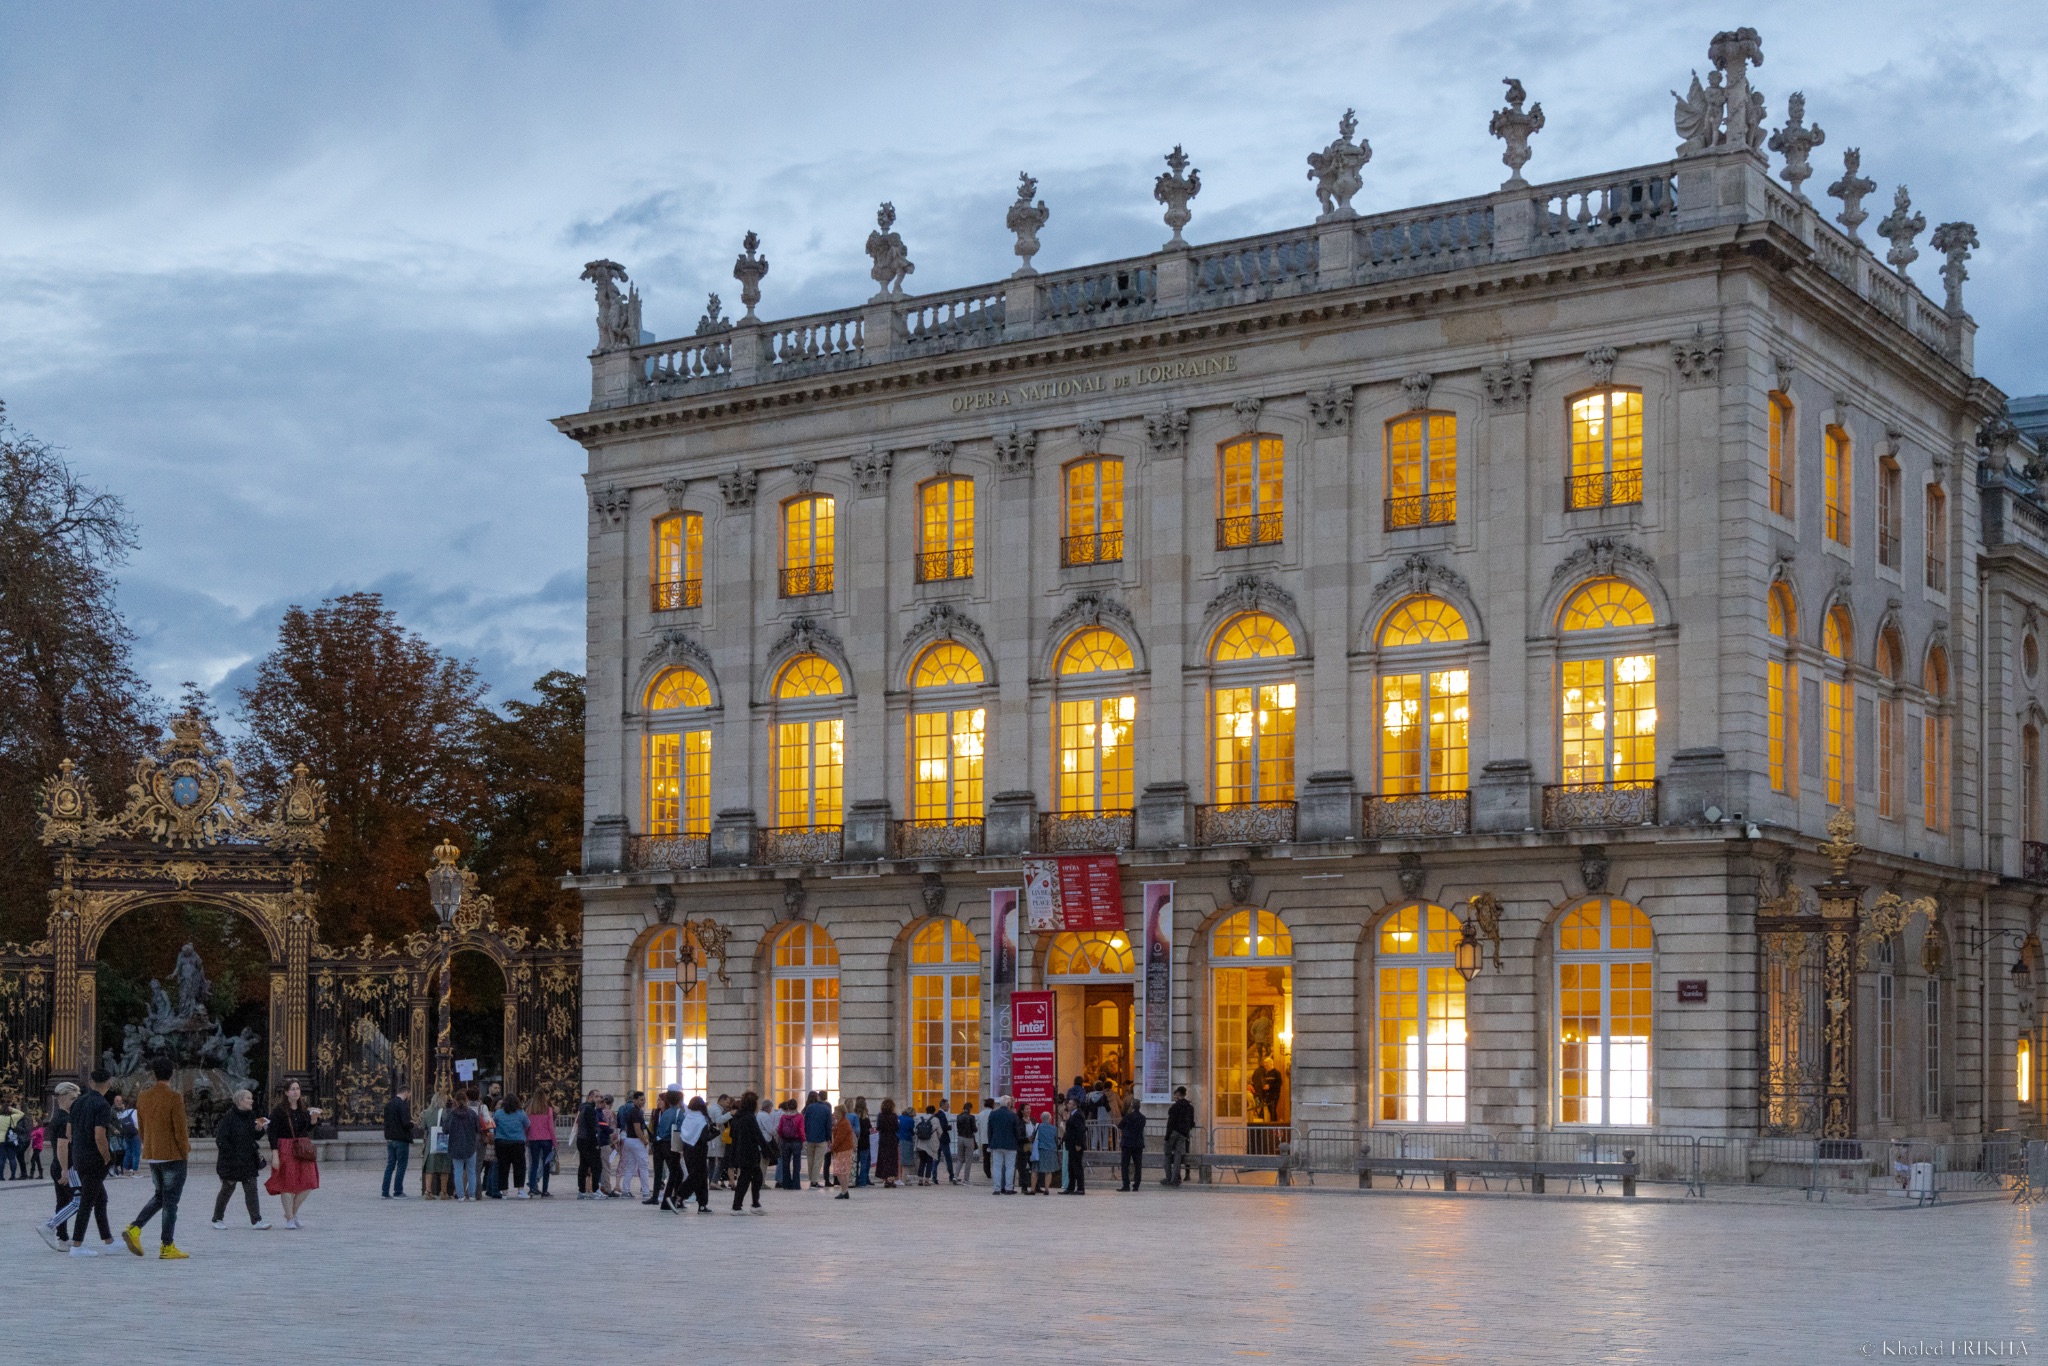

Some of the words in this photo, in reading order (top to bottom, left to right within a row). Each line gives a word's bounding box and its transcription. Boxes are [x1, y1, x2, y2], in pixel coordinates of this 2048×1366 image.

[950, 390, 1010, 412] OPERA
[1019, 376, 1106, 402] NATIONAL
[1113, 376, 1130, 389] DE
[1137, 355, 1237, 385] LORRAINE
[1019, 1020, 1045, 1033] inter
